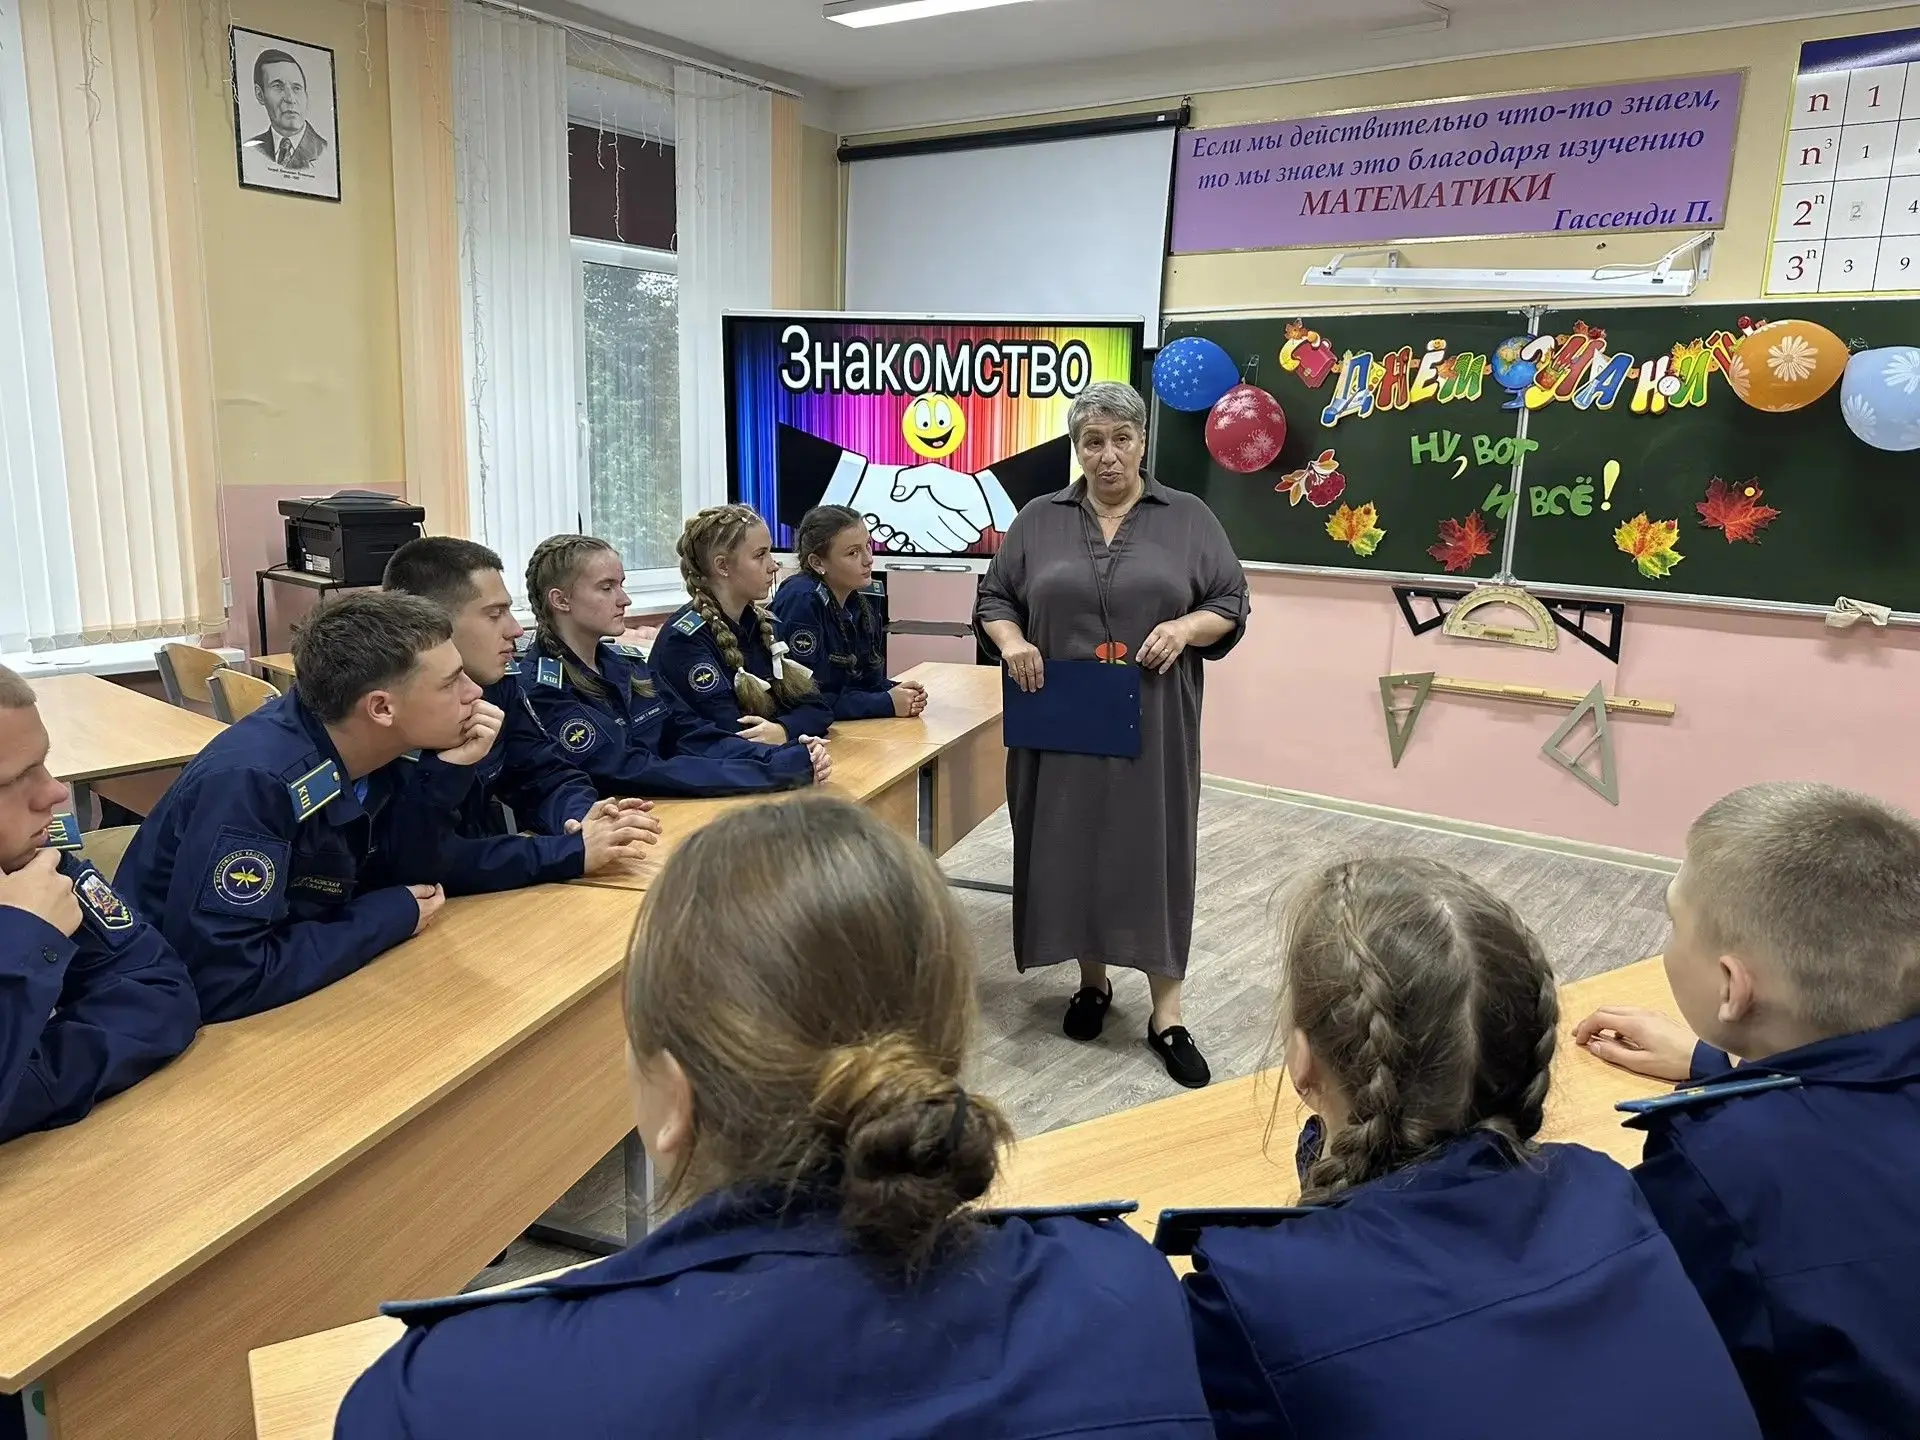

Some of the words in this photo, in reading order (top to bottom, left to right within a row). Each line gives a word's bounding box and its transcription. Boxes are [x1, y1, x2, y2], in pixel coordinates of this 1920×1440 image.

[1807, 93, 1830, 112] n
[1867, 85, 1881, 108] 1
[1191, 136, 1242, 158] Если
[1247, 134, 1284, 152] мы
[1290, 111, 1488, 147] действительно
[1497, 98, 1612, 127] что-то
[1621, 88, 1720, 115] знаем,
[1198, 172, 1229, 190] то
[1235, 167, 1271, 186] мы
[1276, 161, 1344, 182] знаем
[1350, 156, 1400, 176] это
[1408, 140, 1551, 172] благодаря
[1558, 129, 1705, 164] изучению
[1862, 145, 1870, 159] 1
[1299, 172, 1556, 216] МАТЕМАТИКИ
[1851, 204, 1862, 219] 2
[1908, 199, 1919, 214] 4
[1552, 202, 1676, 231] Гассенди
[1683, 200, 1714, 223] П.
[1843, 259, 1854, 273] 3
[1900, 256, 1911, 271] 9
[780, 324, 1090, 396] Знакомство
[1320, 339, 1487, 427] ДНЁМ
[1472, 434, 1539, 466] ВОТ
[297, 784, 311, 810] КШ
